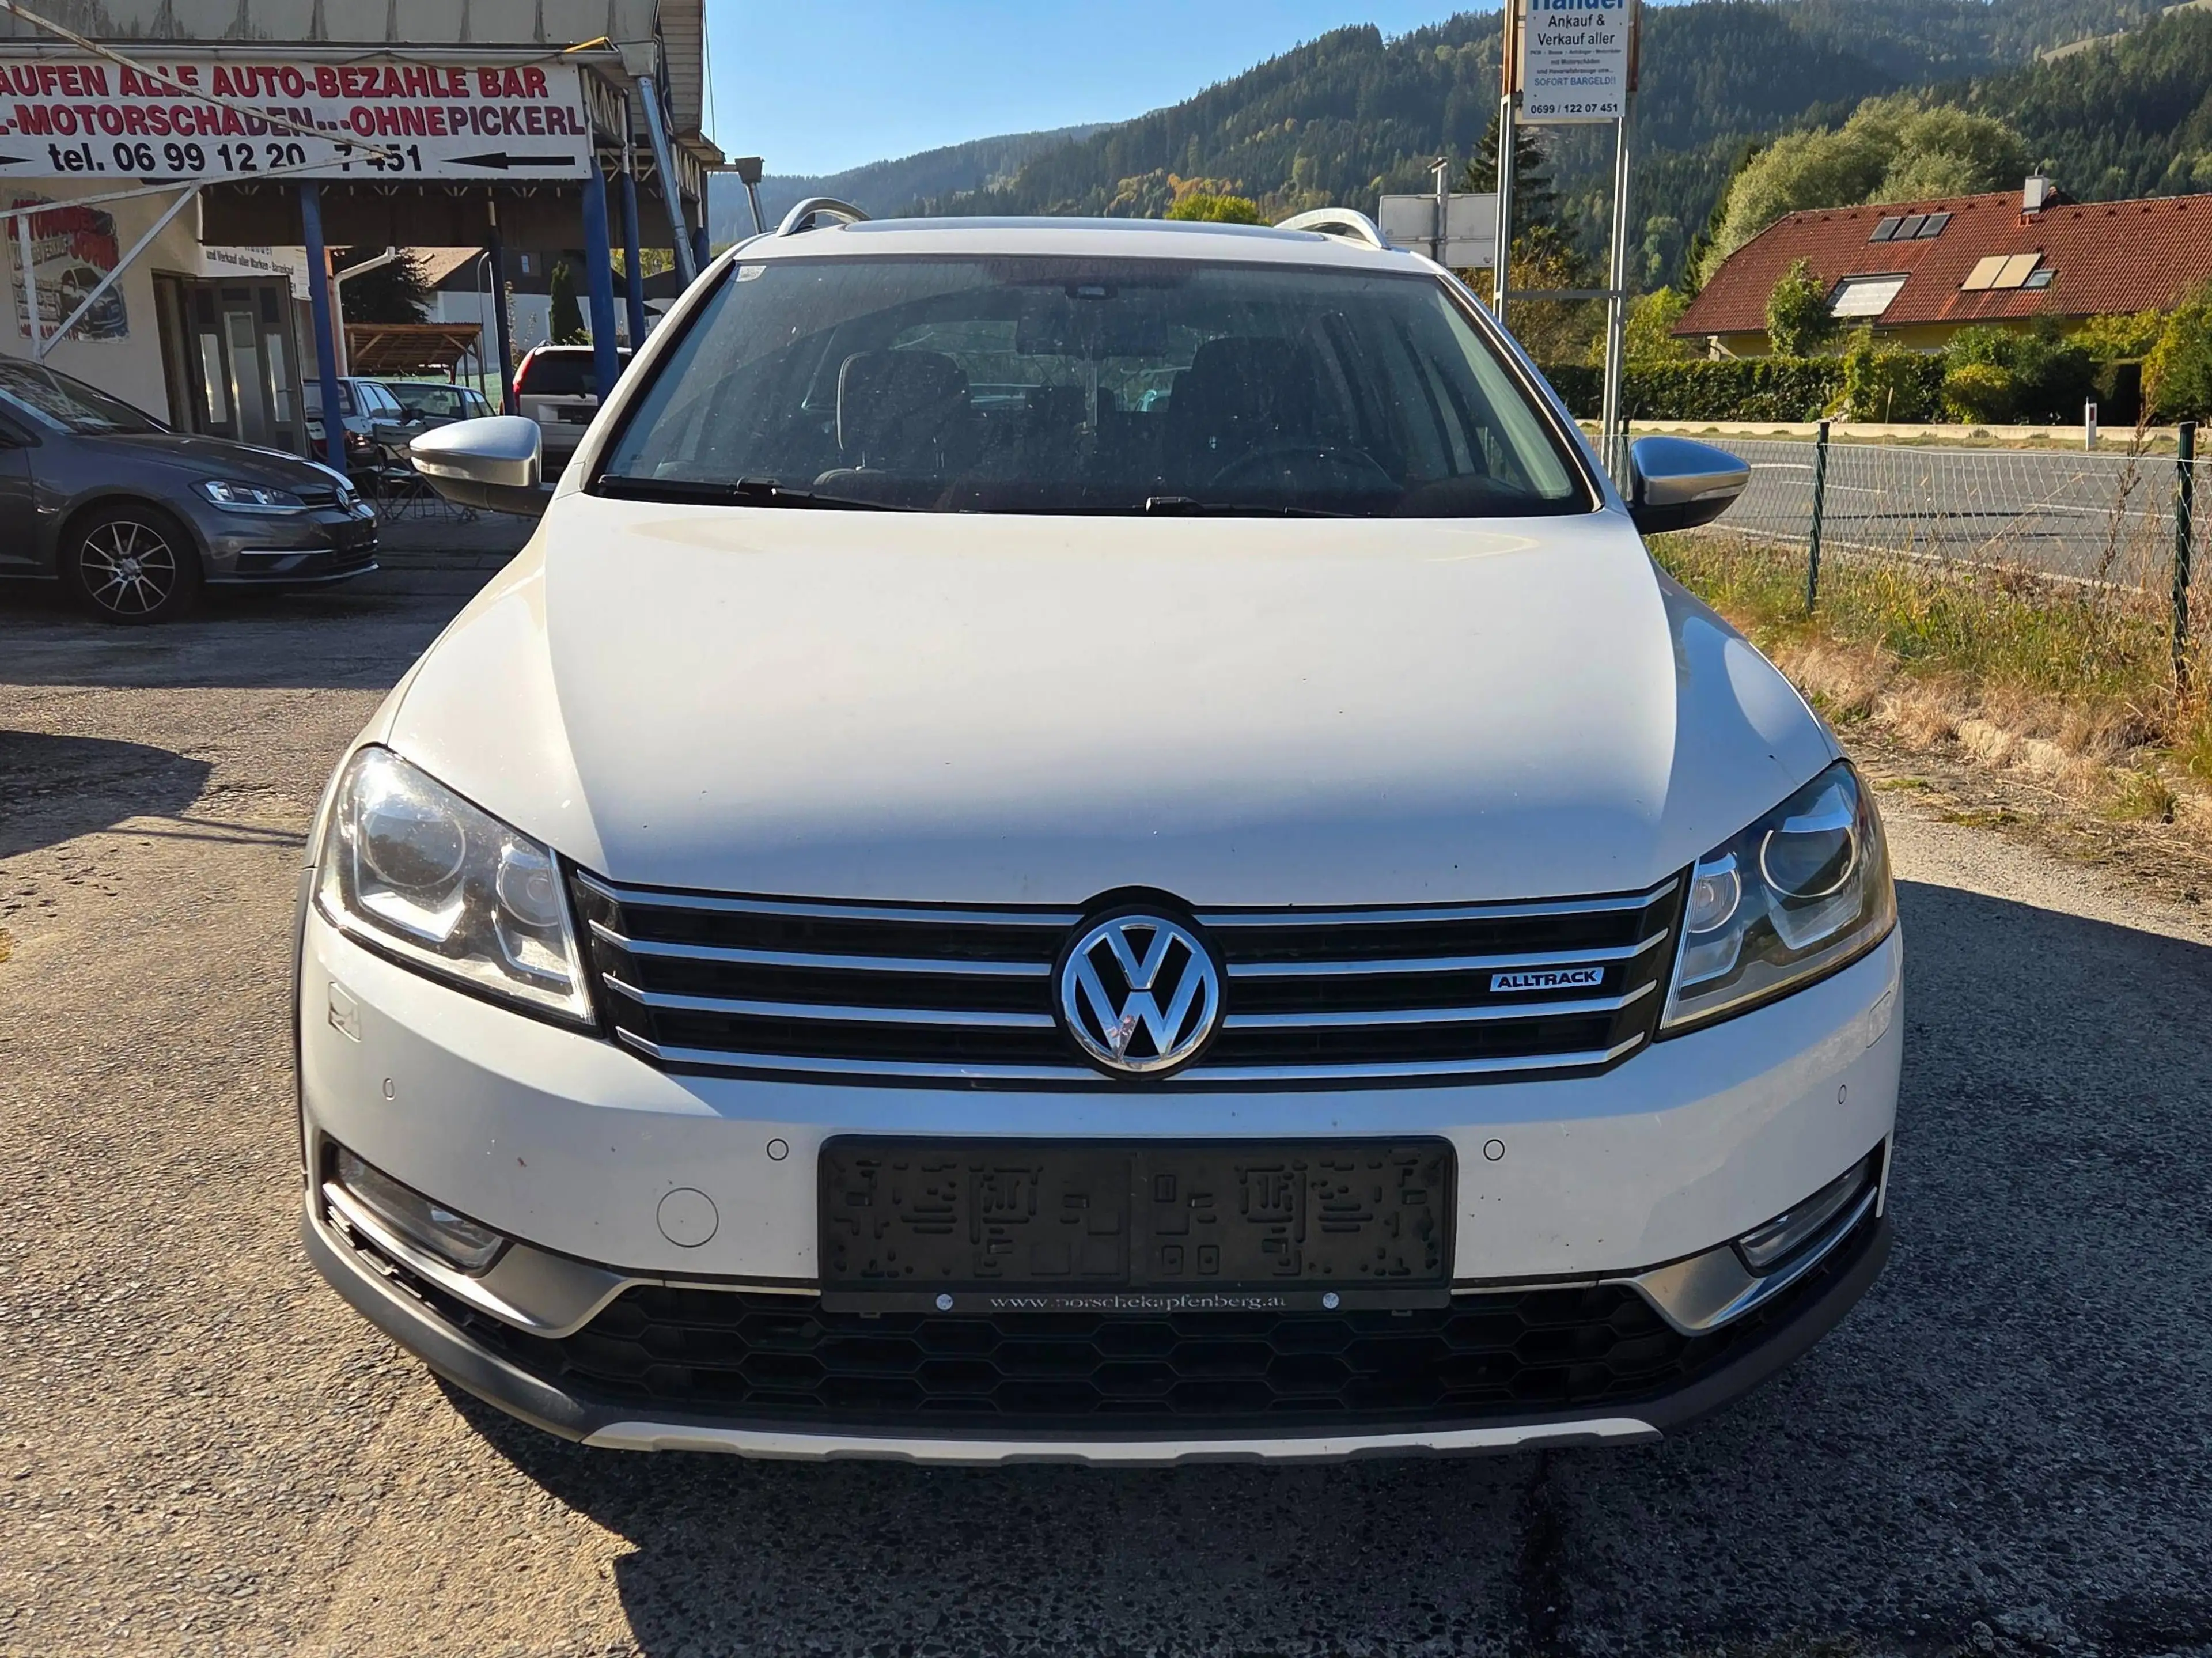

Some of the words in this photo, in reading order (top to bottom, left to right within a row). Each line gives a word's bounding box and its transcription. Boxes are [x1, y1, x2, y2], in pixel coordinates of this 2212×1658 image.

[1548, 14, 1593, 28] Ankauf
[1596, 13, 1605, 27] &
[1537, 32, 1585, 46] Verkauf
[1588, 31, 1616, 44] aller
[120, 65, 199, 97] ALLE
[213, 66, 470, 98] AUTO-BEZAHLE
[478, 66, 549, 98] BAR
[1535, 77, 1569, 86] SOFORT
[1531, 104, 1555, 114] 0699
[1563, 104, 1582, 113] 122
[1585, 103, 1597, 112] 07
[1600, 103, 1618, 112] 451
[48, 143, 105, 171] tel.
[113, 142, 155, 171] 06
[163, 142, 206, 171] 99
[217, 143, 257, 171] 12
[266, 142, 306, 168] 20
[1497, 969, 1598, 988] ALLTRACK
